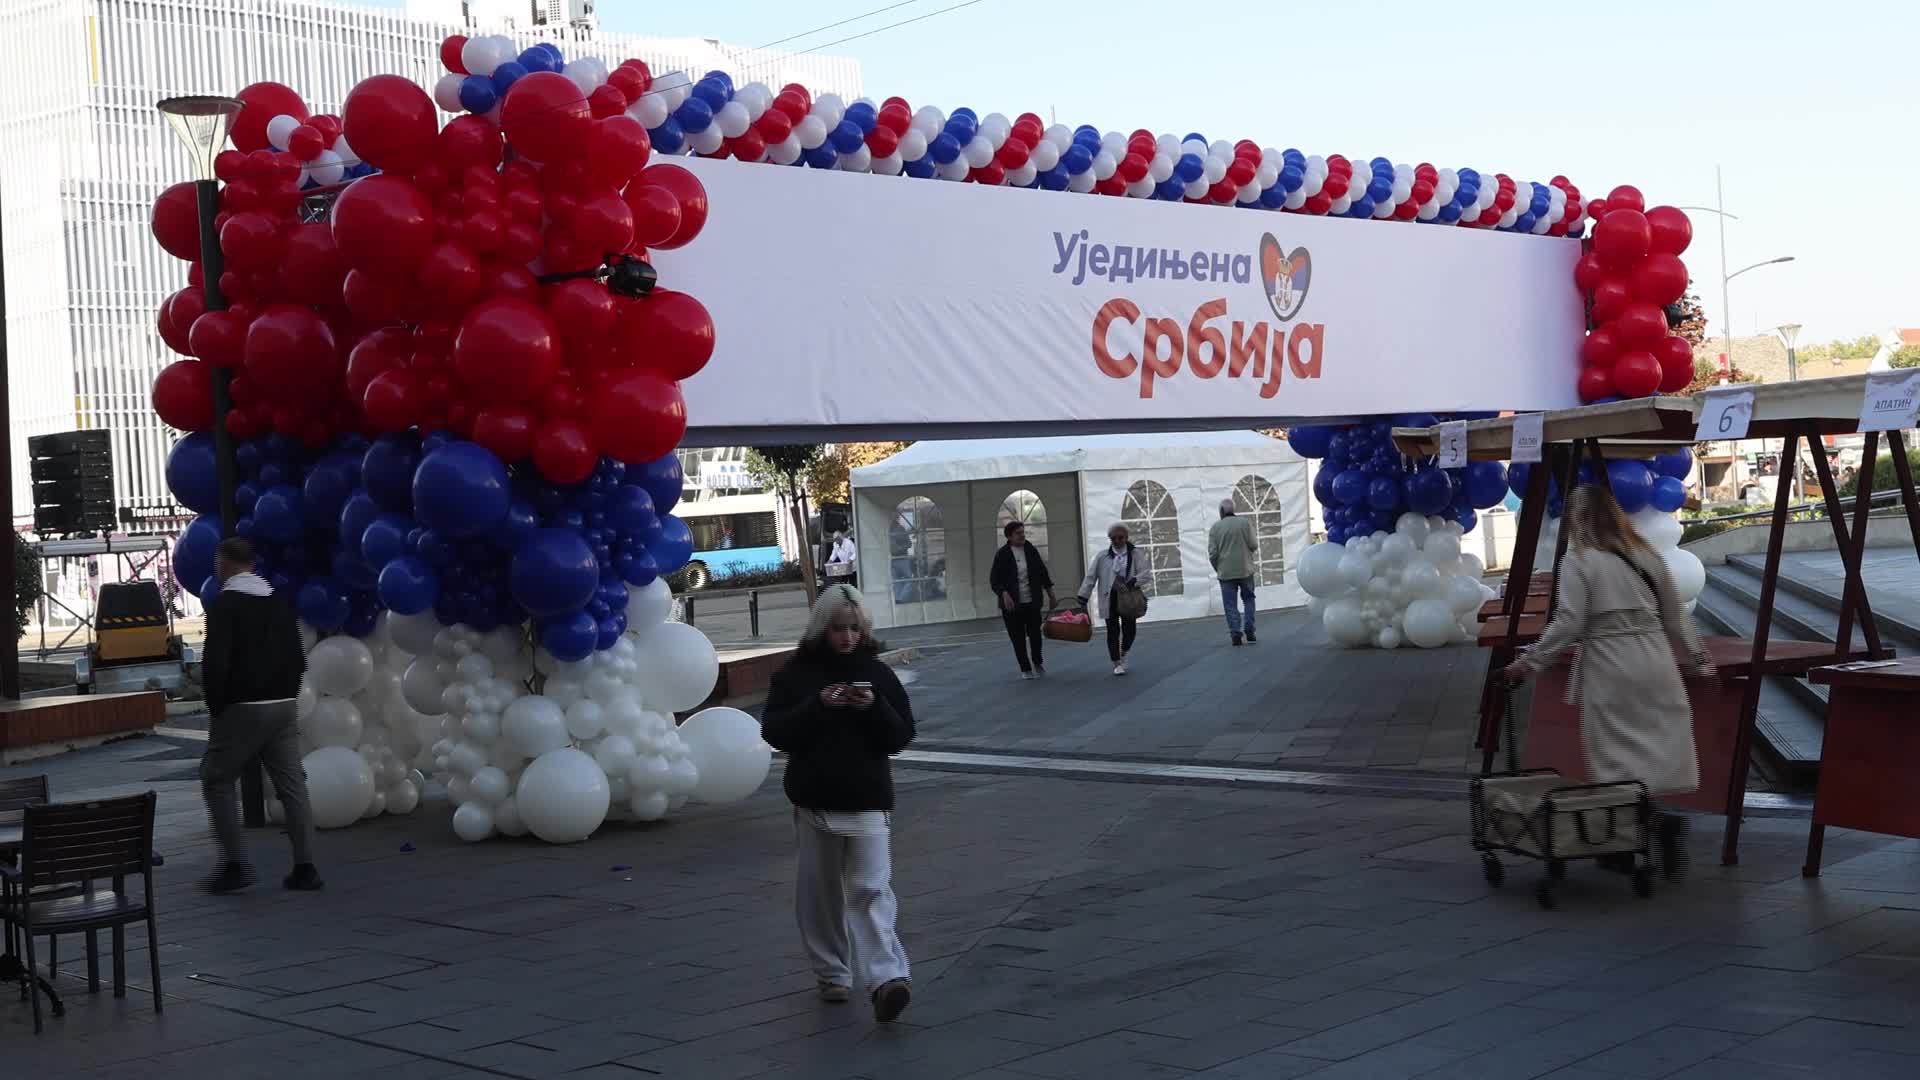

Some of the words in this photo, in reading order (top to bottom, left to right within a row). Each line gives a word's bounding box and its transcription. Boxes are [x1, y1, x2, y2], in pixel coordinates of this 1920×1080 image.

[1053, 229, 1251, 285] Уједињена
[1092, 298, 1325, 399] Србија
[1874, 399, 1912, 410] АПАТИН
[1718, 405, 1736, 433] 6
[1449, 438, 1459, 462] 5
[131, 507, 170, 518] Teodora
